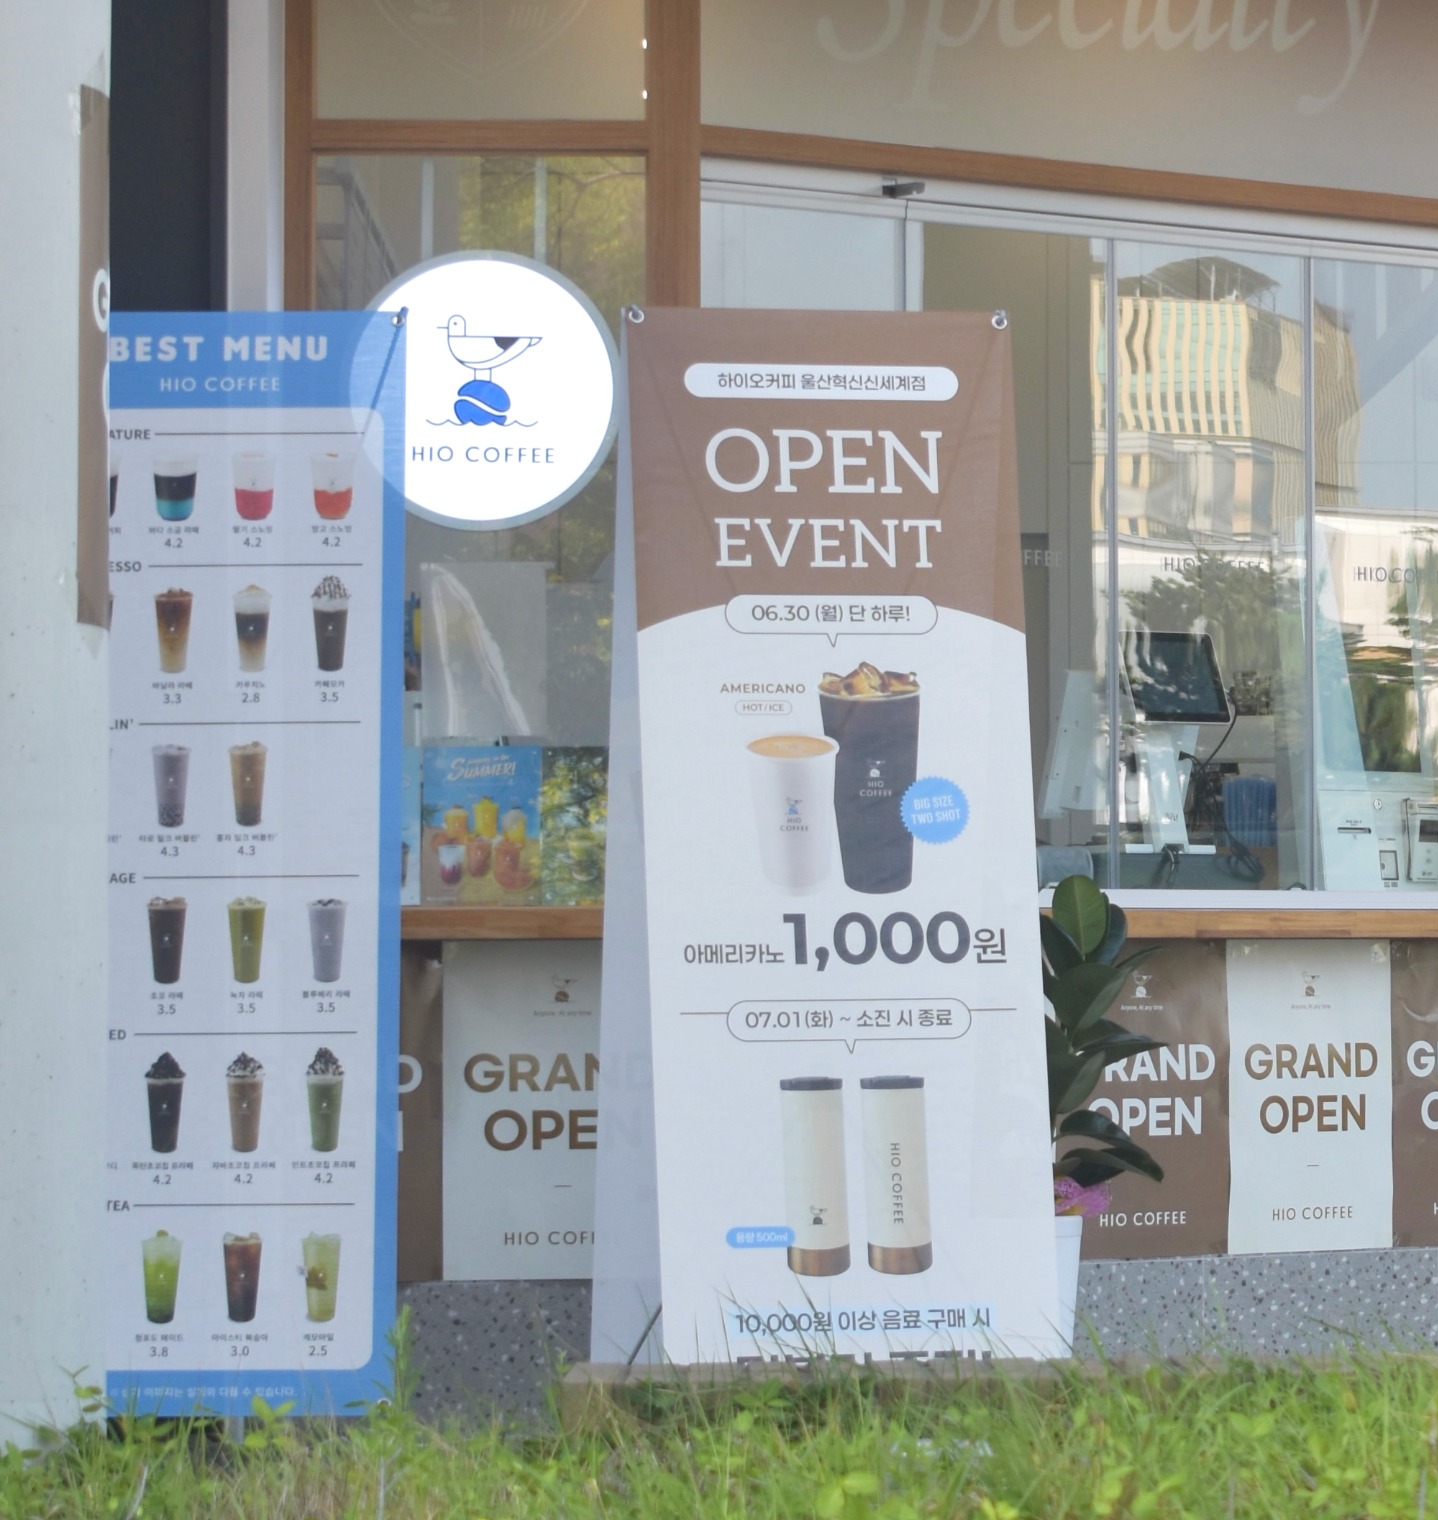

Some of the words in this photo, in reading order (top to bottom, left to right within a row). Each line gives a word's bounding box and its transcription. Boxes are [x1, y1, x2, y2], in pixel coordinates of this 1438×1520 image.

[109, 336, 204, 362] BEST
[224, 336, 328, 362] MENU
[160, 377, 197, 392] HIO
[204, 376, 281, 392] COFFEE
[717, 372, 796, 390] 하이오커피
[800, 373, 926, 392] 울산혁신신세계점
[109, 429, 151, 440] ATURE
[412, 446, 454, 463] HIO
[465, 446, 555, 464] COFFEE
[705, 428, 943, 495] OPEN
[164, 538, 184, 549] 4.2
[243, 537, 262, 548] 4.2
[322, 536, 341, 547] 4.2
[714, 518, 942, 568] EVENT
[109, 562, 142, 572] ESSO
[751, 605, 810, 622] 06.30
[815, 604, 844, 624] (월)
[849, 605, 867, 622] 단
[871, 604, 910, 623] 하루!
[720, 683, 806, 695] AMERICANO
[163, 693, 182, 704] 3.3
[241, 692, 260, 703] 2.8
[320, 691, 339, 702] 3.5
[913, 798, 931, 810] BIG
[933, 796, 954, 809] SIZE
[911, 812, 934, 825] TWO
[936, 808, 961, 823] SHOT
[160, 846, 180, 857] 4.3
[237, 845, 256, 856] 4.3
[157, 1004, 177, 1015] 3.5
[237, 1003, 256, 1014] 3.5
[316, 1002, 336, 1013] 3.5
[856, 1009, 892, 1028] 소진
[897, 1009, 913, 1027] 시
[917, 1008, 953, 1027] 종료
[1104, 1043, 1216, 1083] RAND
[1244, 1042, 1378, 1081] GRAND
[1259, 1094, 1367, 1135] OPEN
[484, 1109, 598, 1152] OPE
[890, 1143, 902, 1168] HIO
[152, 1174, 172, 1185] 4.2
[234, 1173, 253, 1184] 4.2
[314, 1172, 333, 1183] 4.2
[892, 1173, 904, 1225] COFFEE
[1099, 1213, 1129, 1228] HIO
[1133, 1211, 1187, 1226] COFFEE
[1271, 1207, 1297, 1222] HIO
[1302, 1206, 1354, 1221] COFFEE
[505, 1231, 540, 1246] HIO
[756, 1231, 788, 1243] 500ml
[737, 1311, 832, 1334] 10,000원
[838, 1310, 877, 1332] 이상
[883, 1309, 921, 1330] 음료
[927, 1308, 966, 1329] 구매
[972, 1308, 991, 1327] 시
[150, 1346, 169, 1357] 3.8
[230, 1345, 249, 1356] 3.0
[308, 1345, 328, 1356] 2.5
